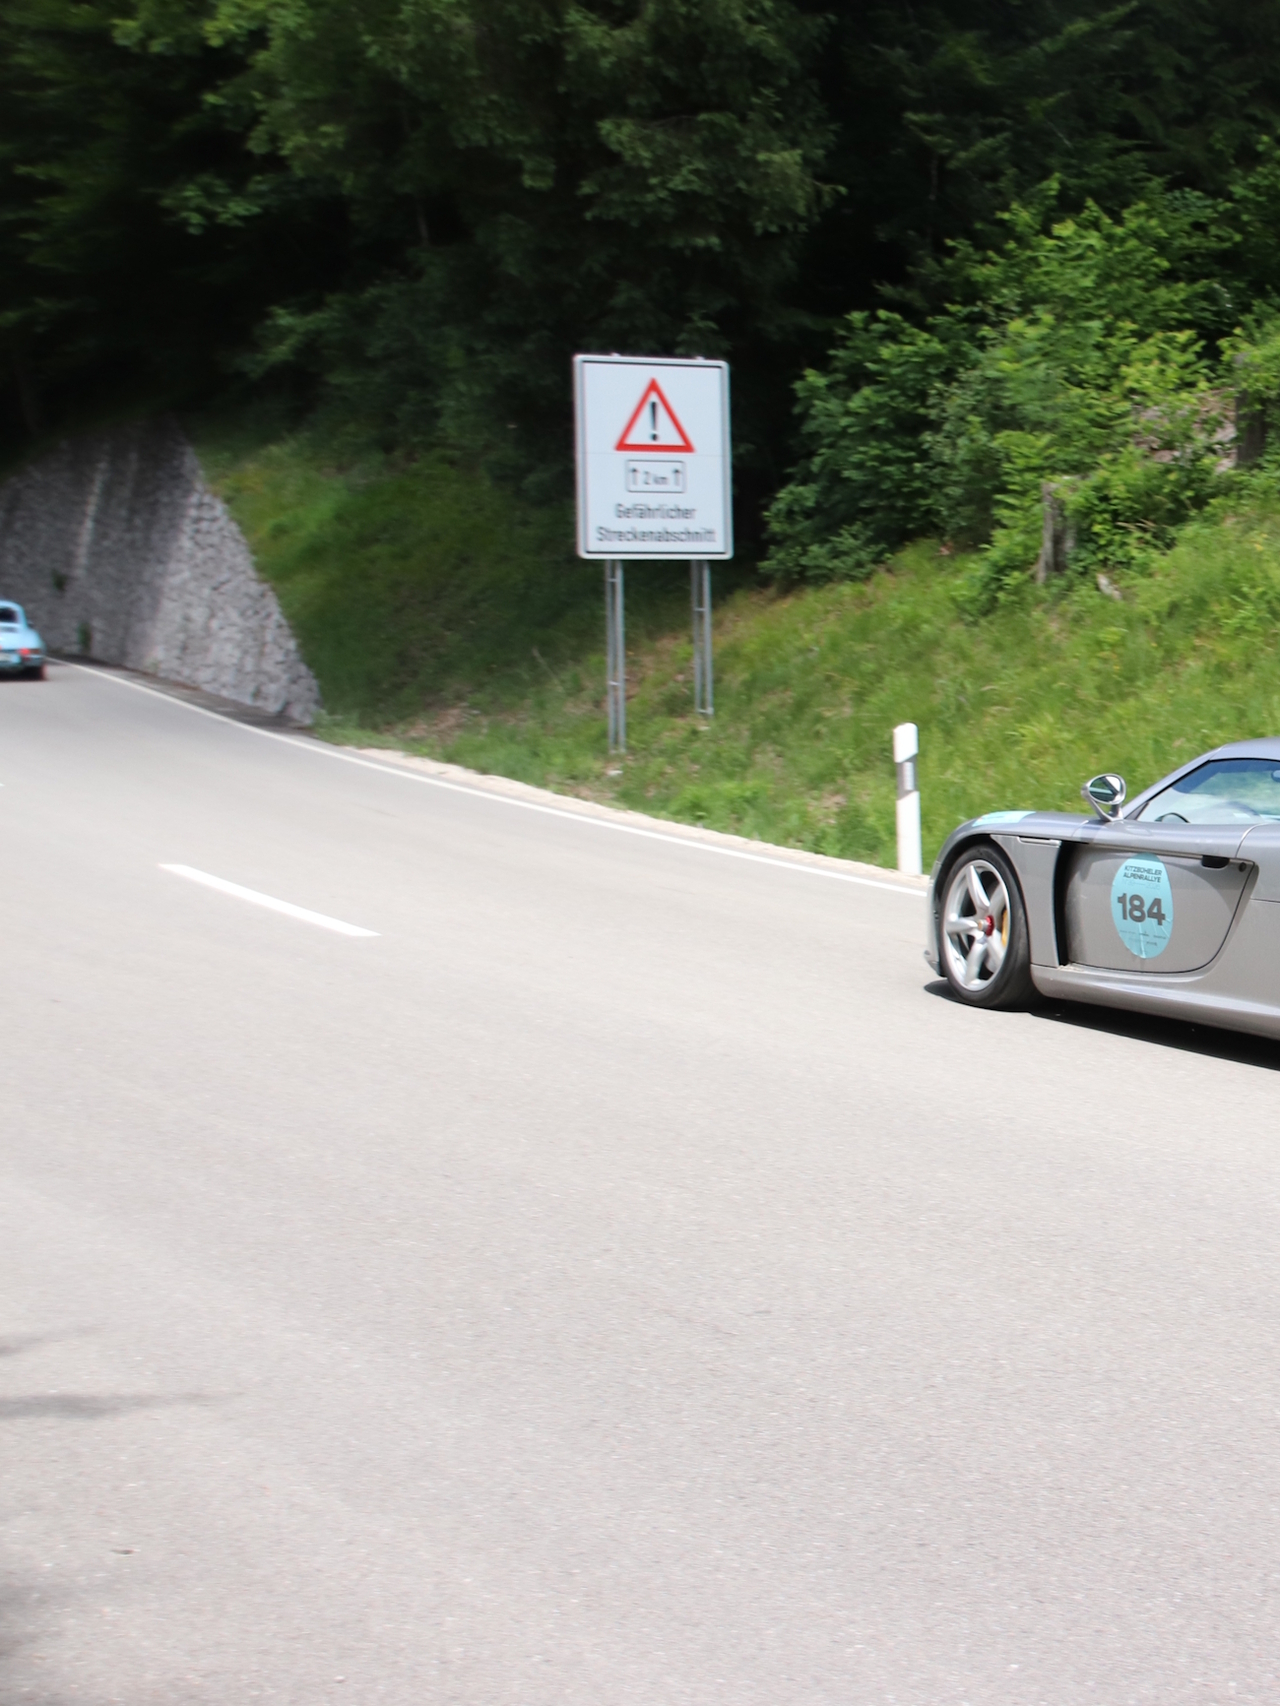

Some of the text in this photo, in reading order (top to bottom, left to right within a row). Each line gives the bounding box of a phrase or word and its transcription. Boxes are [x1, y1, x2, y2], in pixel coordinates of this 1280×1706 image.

[643, 471, 668, 486] 2 km
[614, 502, 696, 519] Gefährlicher
[596, 525, 717, 543] Streckenabschnitt
[1122, 872, 1161, 883] ALPENRALLYE
[1117, 892, 1166, 926] 184
